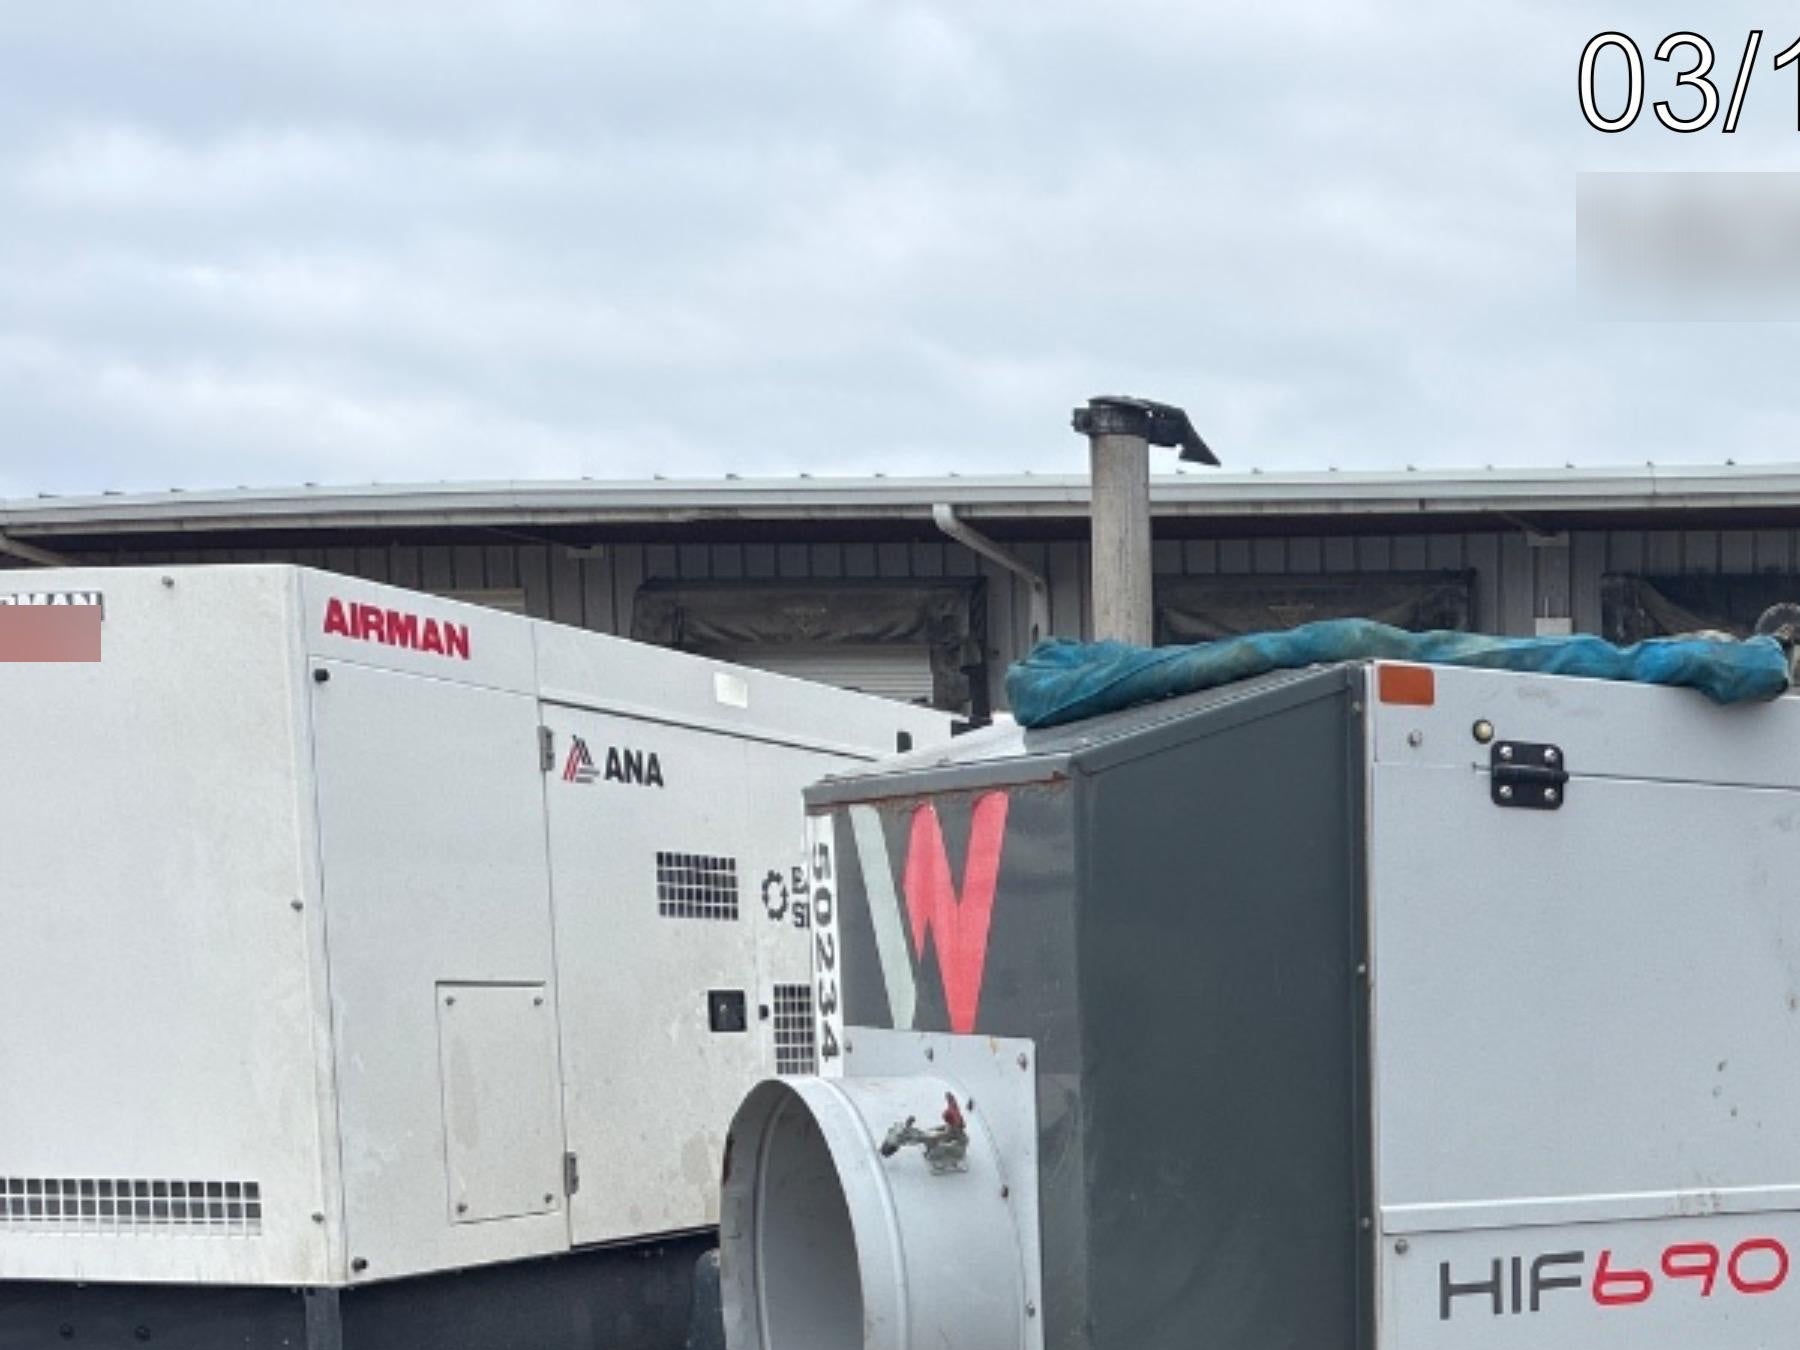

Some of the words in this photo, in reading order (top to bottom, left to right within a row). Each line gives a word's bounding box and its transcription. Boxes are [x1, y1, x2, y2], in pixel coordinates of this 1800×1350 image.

[323, 597, 471, 661] AIRMAN
[604, 745, 664, 788] ANA
[812, 842, 840, 1062] 50234
[1439, 1238, 1790, 1320] HIF690
